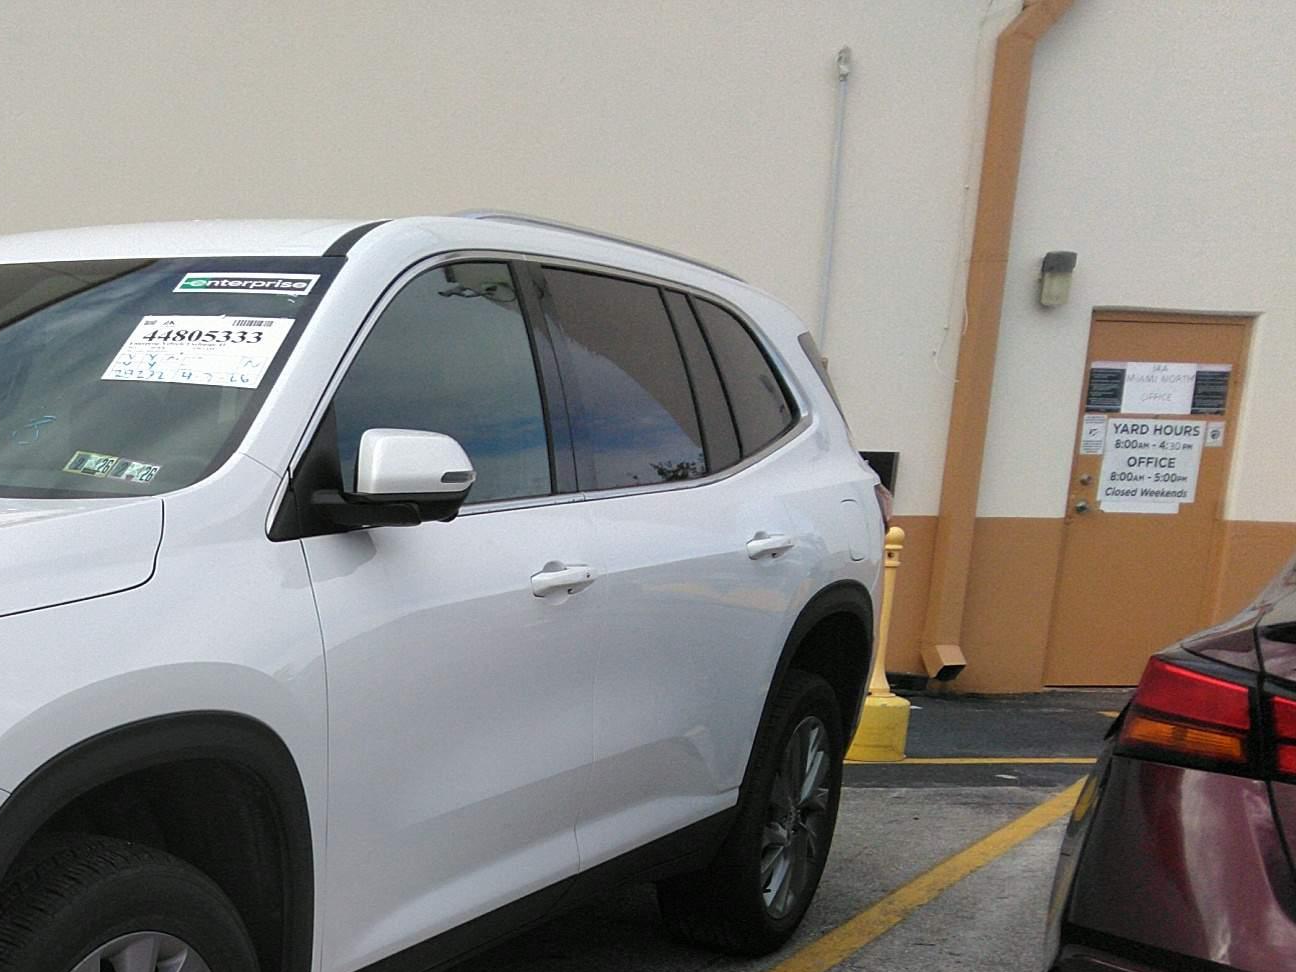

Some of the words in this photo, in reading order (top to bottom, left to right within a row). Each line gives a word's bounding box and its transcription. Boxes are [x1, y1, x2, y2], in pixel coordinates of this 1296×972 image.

[191, 277, 308, 290] enterprise
[142, 329, 264, 344] 44805333
[1113, 423, 1149, 436] YARD
[1153, 425, 1201, 437] HOURS
[1127, 457, 1176, 469] OFFICE
[1105, 487, 1137, 498] Closed
[1140, 488, 1188, 499] Weekends
